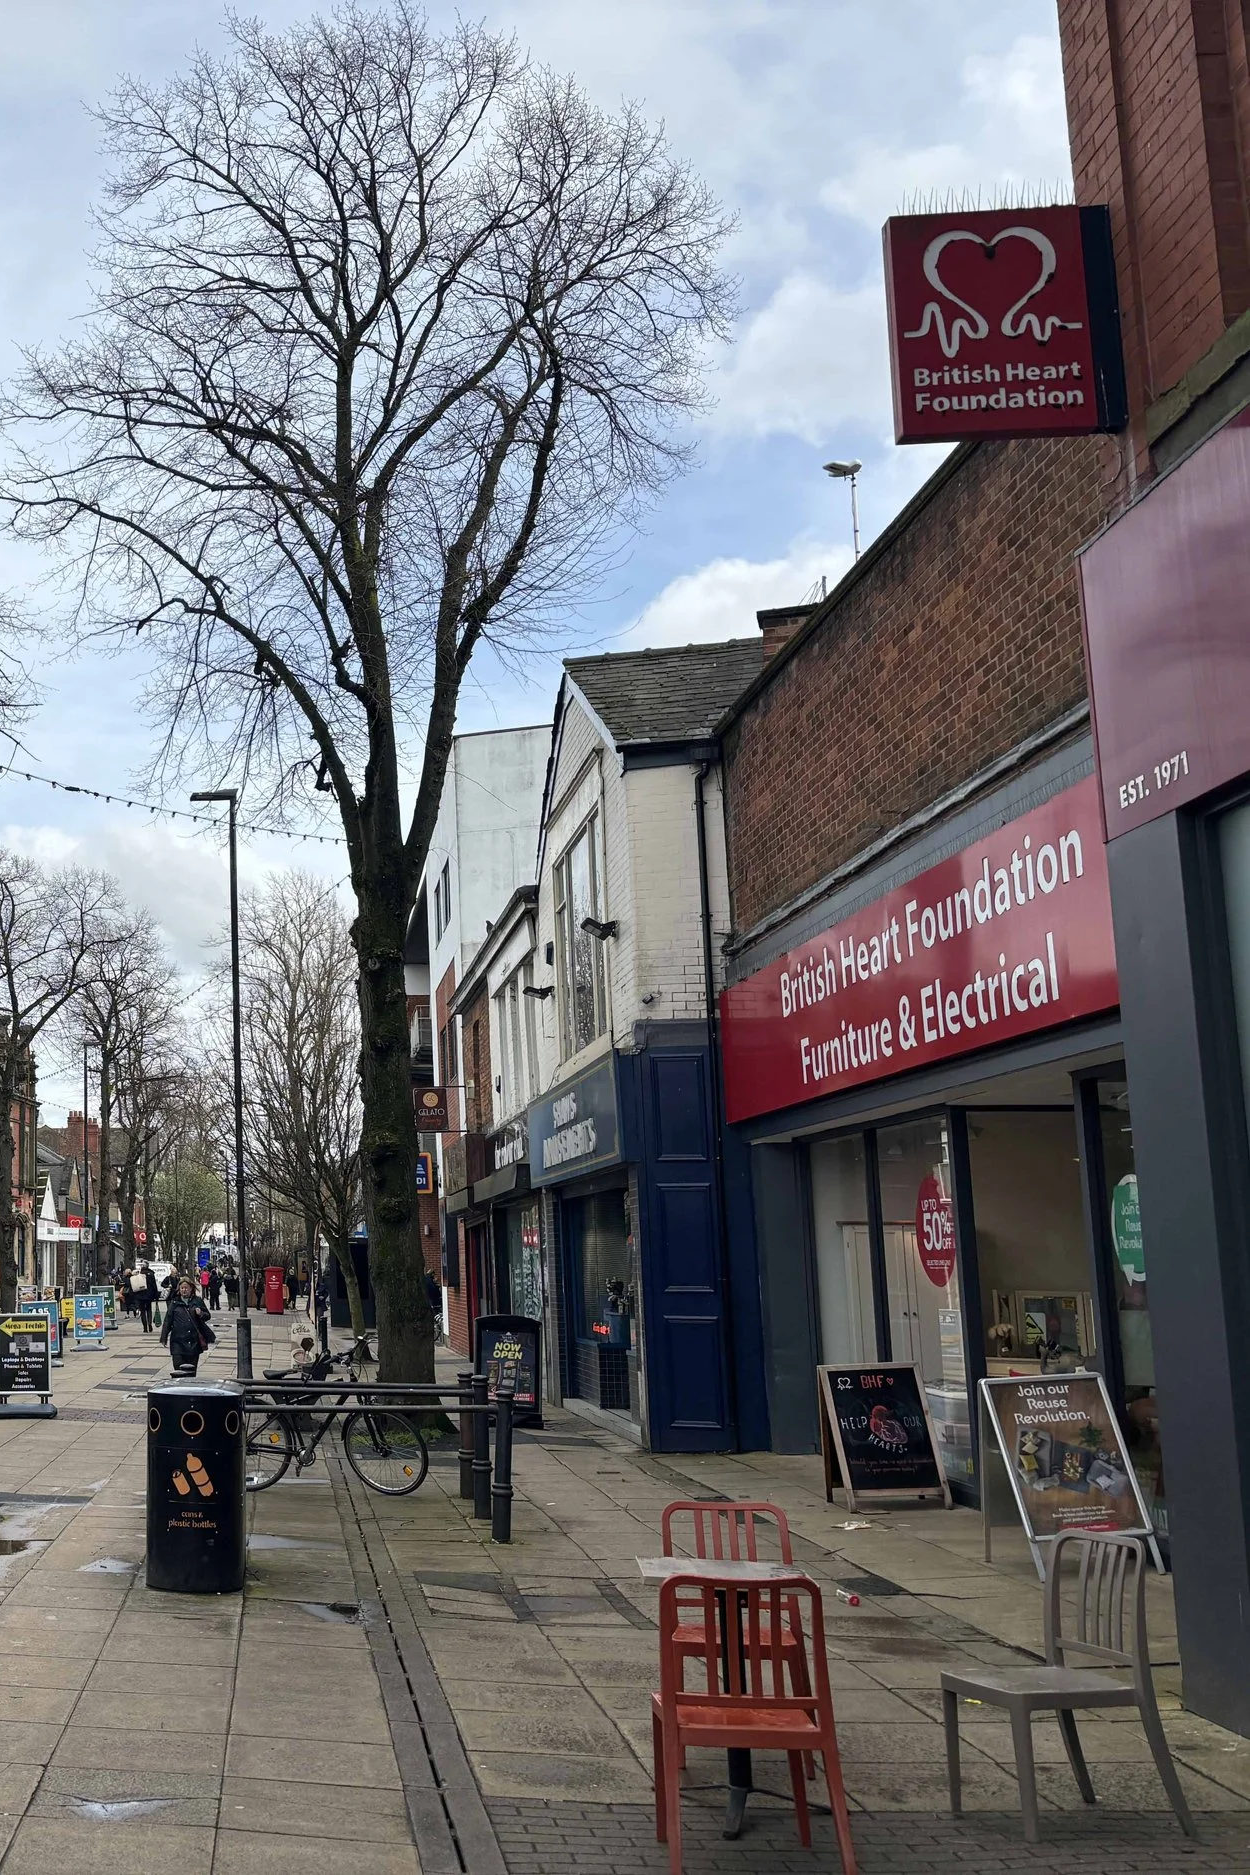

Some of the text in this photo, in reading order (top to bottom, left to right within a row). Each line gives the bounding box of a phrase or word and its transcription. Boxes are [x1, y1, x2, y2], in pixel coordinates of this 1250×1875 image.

[914, 360, 1082, 387] British Heart
[915, 385, 1084, 412] Foundation
[1119, 750, 1189, 809] EST. 1971
[780, 828, 1085, 1018] British Heart Foundation
[800, 931, 1060, 1085] Furniture & Electrical
[921, 1199, 937, 1211] UP TO
[1121, 1202, 1135, 1215] Join
[923, 1211, 950, 1250] 50%
[942, 1238, 952, 1250] OFF
[1119, 1236, 1142, 1249] Revolu
[494, 1342, 521, 1351] NOW
[493, 1350, 522, 1360] OPEN
[860, 1375, 884, 1389] BHF
[1017, 1384, 1069, 1396] Join our
[1026, 1398, 1068, 1410] Reuse
[840, 1416, 922, 1430] HELP OUR
[1014, 1410, 1090, 1425] Revolution.
[169, 1518, 216, 1528] plastic bottles
